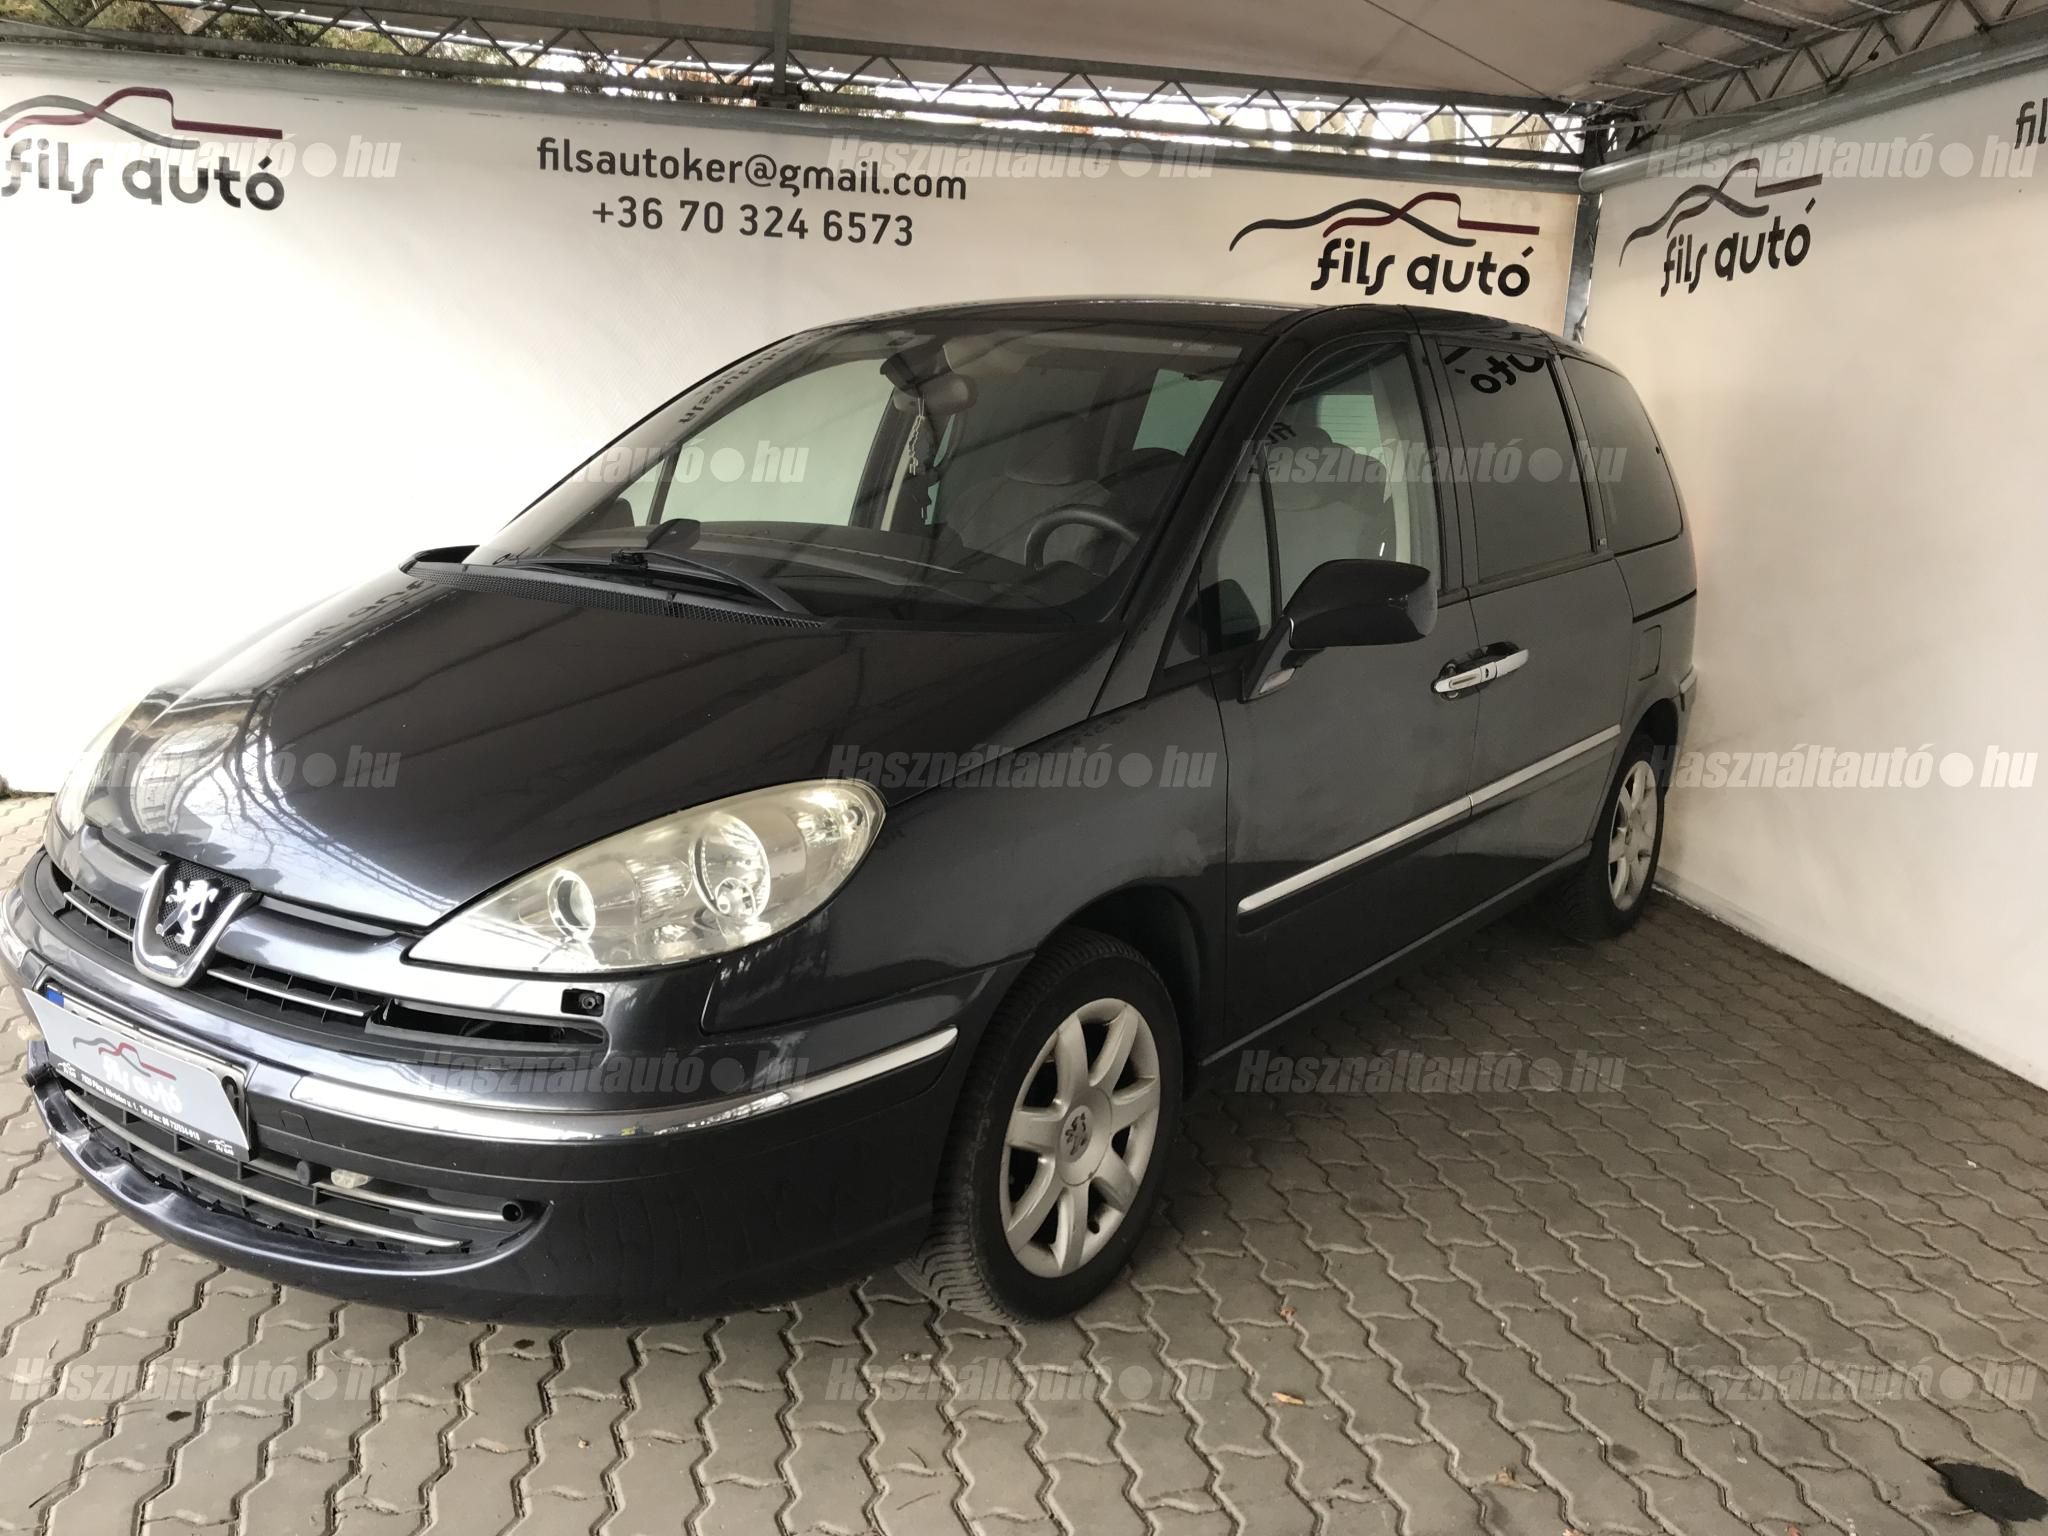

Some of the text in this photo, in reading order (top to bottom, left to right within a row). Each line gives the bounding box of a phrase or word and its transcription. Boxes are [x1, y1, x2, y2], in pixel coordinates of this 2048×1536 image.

[1, 138, 285, 211] fils autó
[537, 137, 967, 199] filsautoker@gmail.com
[592, 196, 913, 246] +36 70 324 6573
[1660, 198, 1816, 297] fils autó
[1310, 237, 1534, 297] fils autó
